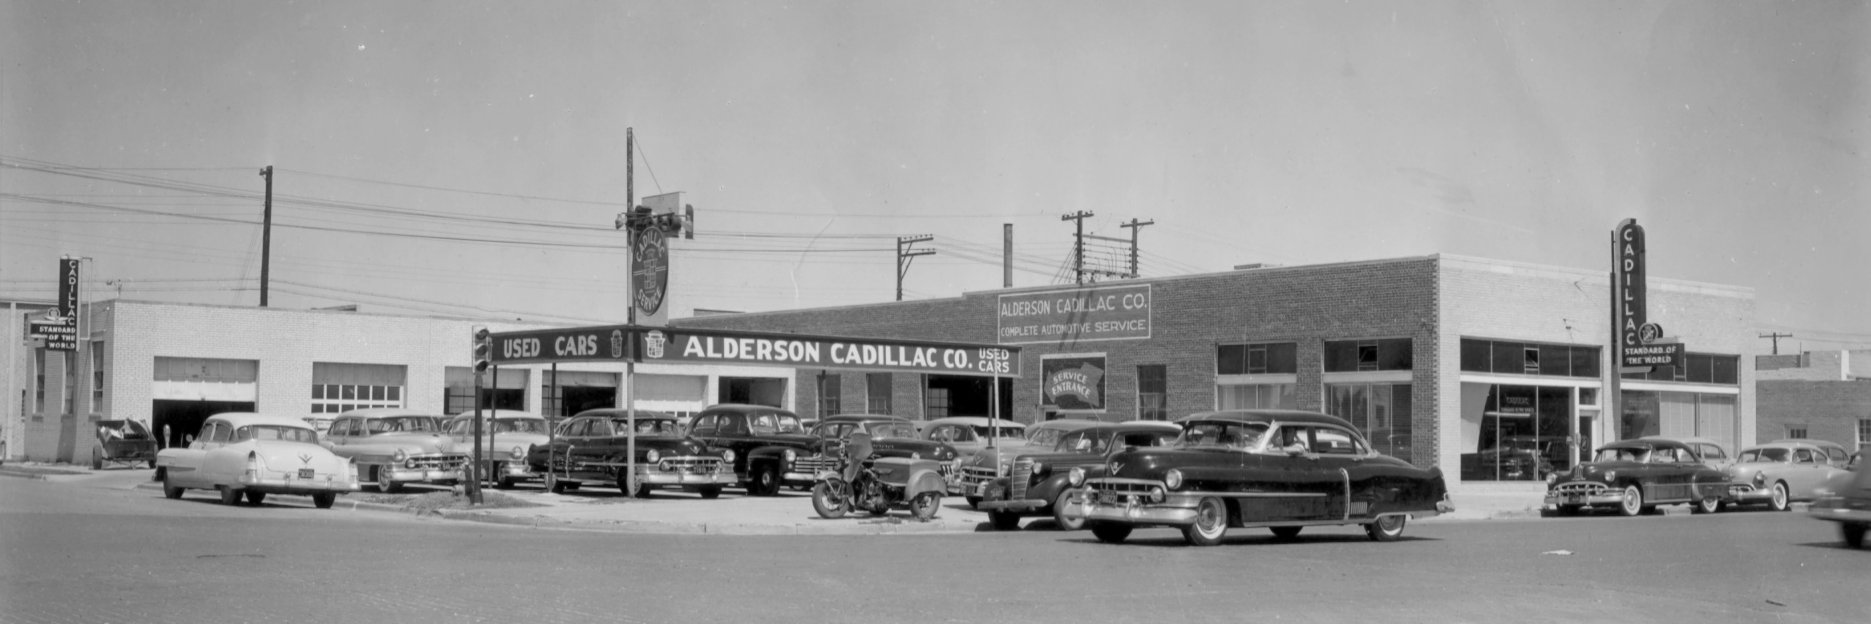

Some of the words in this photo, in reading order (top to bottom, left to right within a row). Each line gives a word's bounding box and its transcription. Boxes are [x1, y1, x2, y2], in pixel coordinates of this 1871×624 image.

[635, 230, 665, 263] CADILLAC
[68, 261, 76, 325] CADILLAC
[1624, 229, 1636, 345] CADILLAC
[637, 288, 662, 310] SERVICE
[1001, 300, 1050, 317] ALDERSON
[1056, 295, 1116, 314] CADILLAC
[1123, 293, 1148, 310] CO.
[1000, 325, 1038, 337] COMPLETE
[1041, 322, 1091, 335] AUTOMOTIVE
[1094, 320, 1146, 332] SERVICE
[503, 337, 541, 358] USED
[555, 334, 597, 356] CARS
[682, 336, 820, 363] ALDERSON
[830, 342, 937, 367] CADILLAC
[943, 348, 973, 369] CO.
[978, 347, 1009, 360] USED
[1625, 346, 1663, 355] STANDARD
[1665, 345, 1676, 354] OF
[978, 360, 1009, 373] CARS
[1628, 356, 1642, 365] THE
[1644, 355, 1672, 364] WORLD
[1053, 371, 1088, 384] SERVICE
[1051, 382, 1091, 399] ENTRANCE
